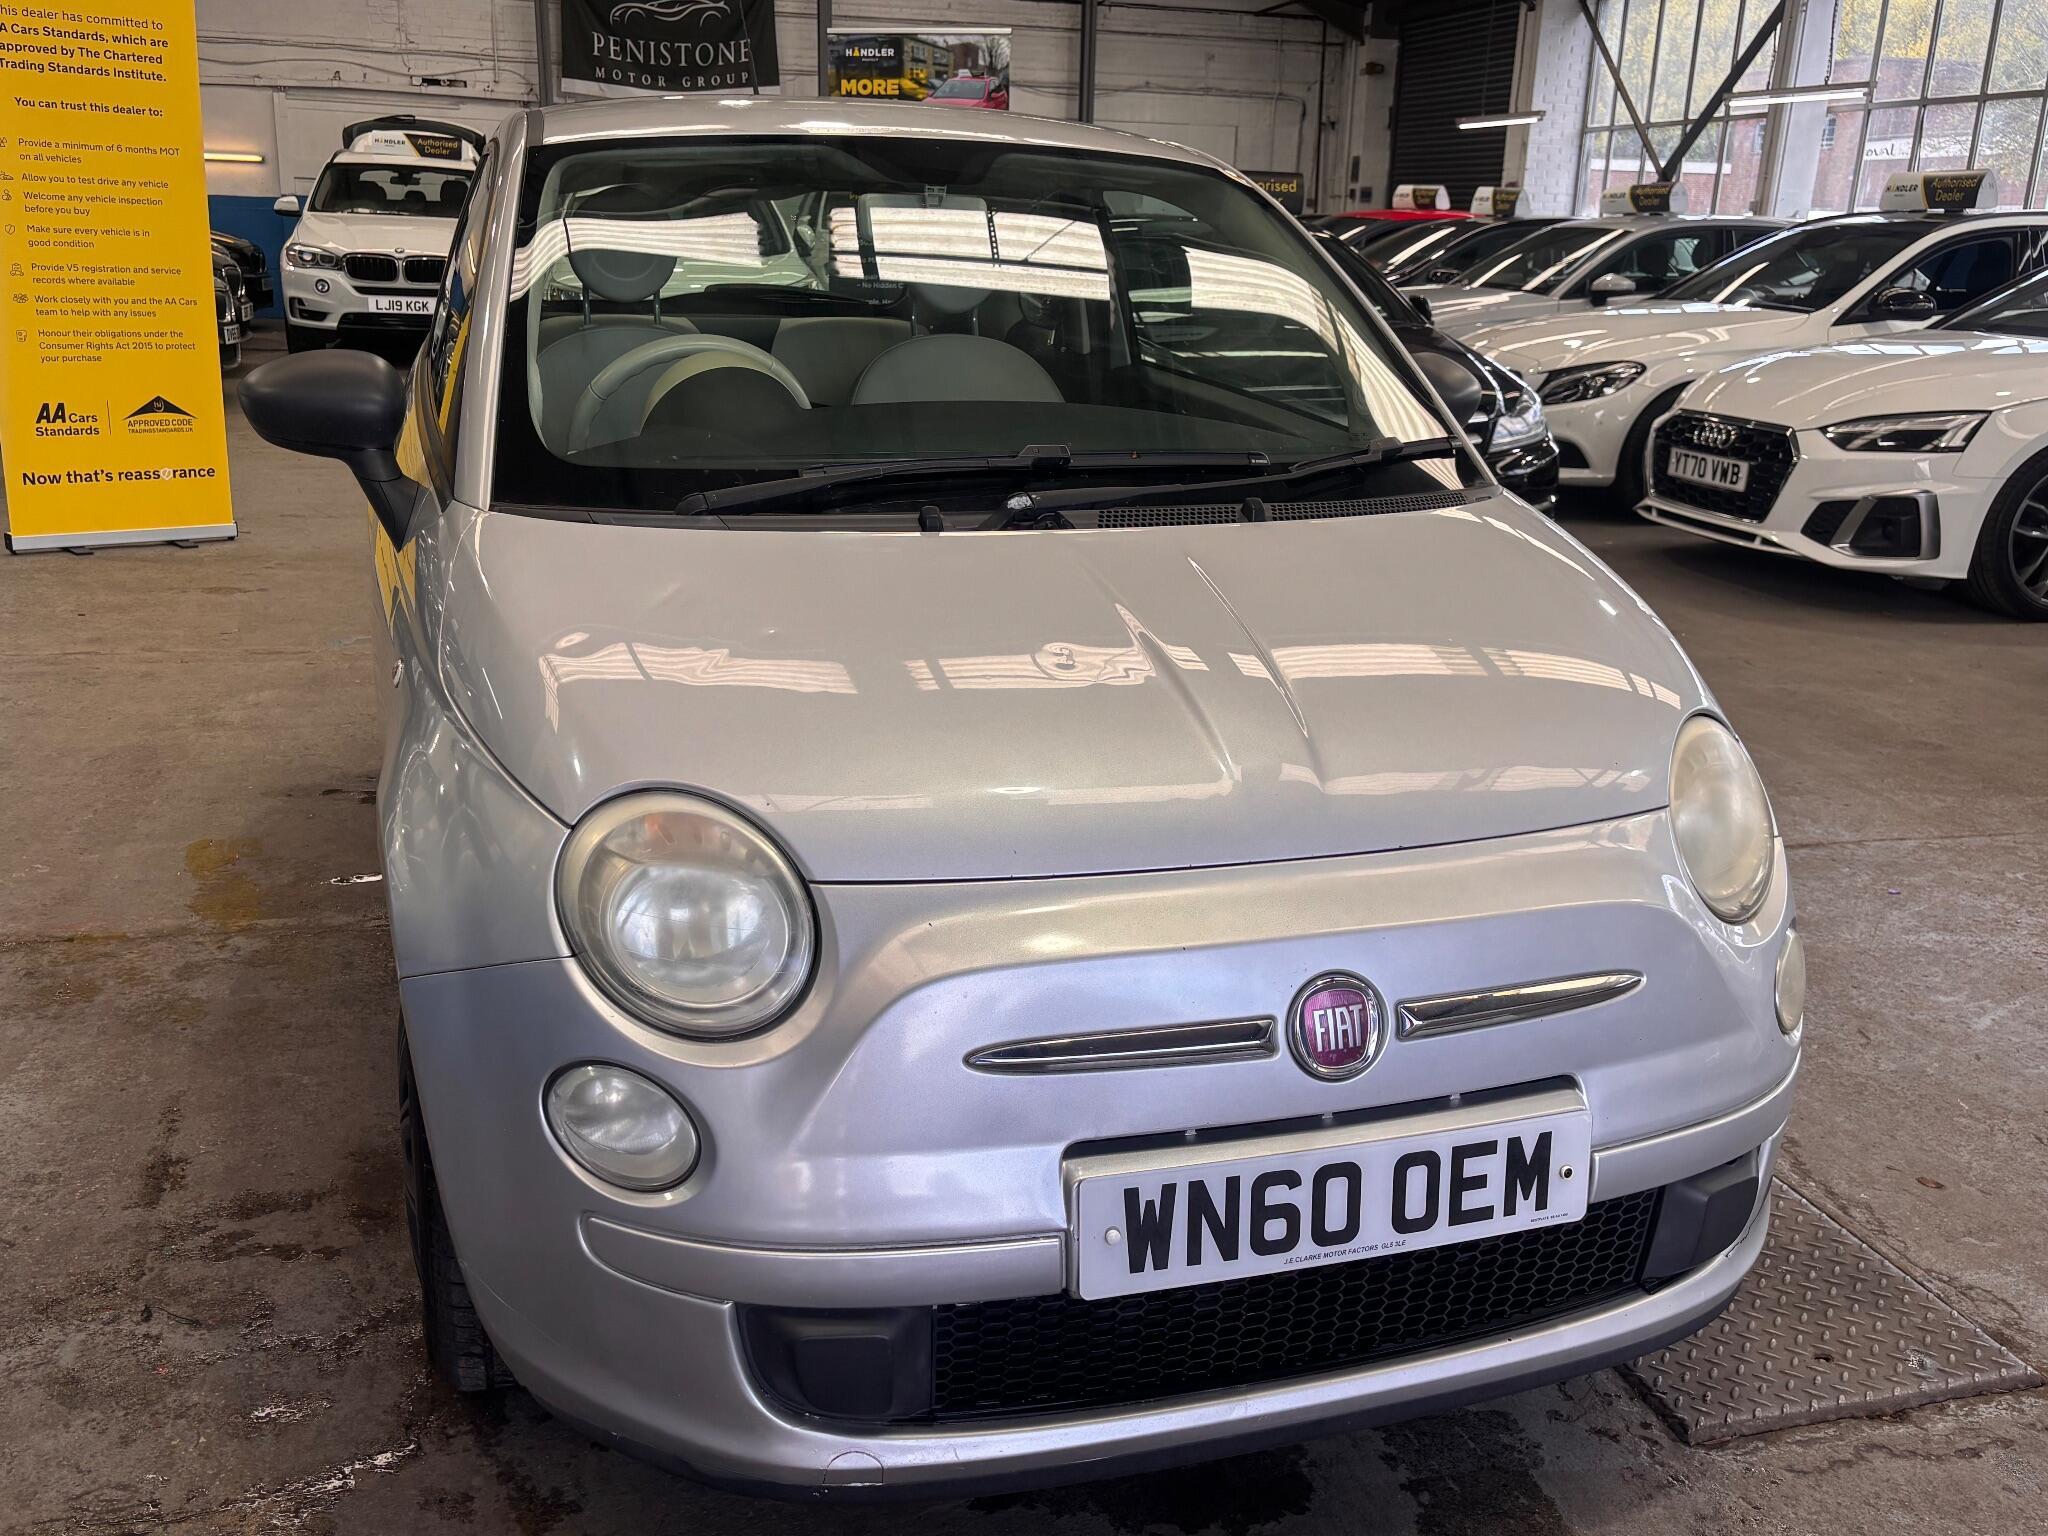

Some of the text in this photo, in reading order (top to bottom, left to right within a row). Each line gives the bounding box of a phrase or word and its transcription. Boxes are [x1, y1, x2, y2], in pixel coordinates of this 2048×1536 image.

[0, 5, 162, 30] his dealer has committed to
[0, 22, 168, 48] A Cars Standards, which are
[0, 42, 162, 64] approved by The Chartered
[592, 31, 750, 67] PENISTONE
[846, 47, 894, 57] HANDLER
[0, 58, 166, 82] Trading Standards Institute.
[595, 67, 749, 88] MOTOR GROUP
[841, 79, 900, 96] MORE
[14, 96, 162, 116] You can trust this dealer to:
[18, 138, 52, 148] Provide
[62, 141, 103, 150] minimum
[116, 144, 122, 152] 6
[126, 146, 157, 154] months
[160, 148, 180, 156] MOT
[417, 138, 458, 148] Authorised
[424, 146, 450, 155] Dealer
[46, 154, 82, 164] vehicles
[22, 173, 168, 188] Allow you to test drive any vehicle
[1931, 176, 1978, 188] Authorised
[24, 192, 162, 206] Welcome any vehicle inspection
[1935, 190, 1964, 202] Dealer
[24, 205, 53, 214] before
[74, 207, 90, 216] buy
[27, 224, 50, 234] Make
[75, 228, 98, 236] every
[100, 228, 130, 236] vehicle
[134, 228, 140, 236] is
[143, 229, 150, 237] in
[28, 239, 94, 248] good condition
[32, 263, 64, 272] Provide
[66, 264, 78, 272] V5
[82, 264, 130, 274] registration
[134, 266, 148, 274] and
[68, 277, 96, 285] where
[98, 278, 136, 286] available
[34, 296, 58, 304] Work
[60, 296, 90, 305] closely
[92, 296, 112, 304] with
[114, 298, 128, 306] you
[131, 297, 146, 305] and
[178, 298, 198, 306] Cars
[376, 299, 429, 312] LJ19 KGK
[71, 308, 90, 317] help
[92, 308, 112, 316] with
[114, 310, 128, 318] any
[130, 309, 156, 318] issues
[38, 329, 70, 337] Honour
[94, 330, 142, 339] obligations
[144, 330, 168, 338] under
[170, 330, 184, 338] the
[39, 342, 84, 350] Consumer
[86, 342, 114, 351] Rights
[156, 342, 164, 350] to
[166, 342, 196, 351] protect
[40, 354, 102, 364] your purchase
[36, 402, 98, 424] AA Cars
[128, 418, 193, 428] APPROVED CODE
[36, 425, 100, 437] Standards
[1675, 451, 1740, 484] YT70 VWB
[22, 472, 62, 486] Now
[66, 469, 114, 484] that's
[1313, 1004, 1362, 1052] FIAT
[1124, 1131, 1552, 1274] WN60 OEM
[1323, 1250, 1346, 1260] MOTOR
[1348, 1245, 1378, 1256] FACTORS
